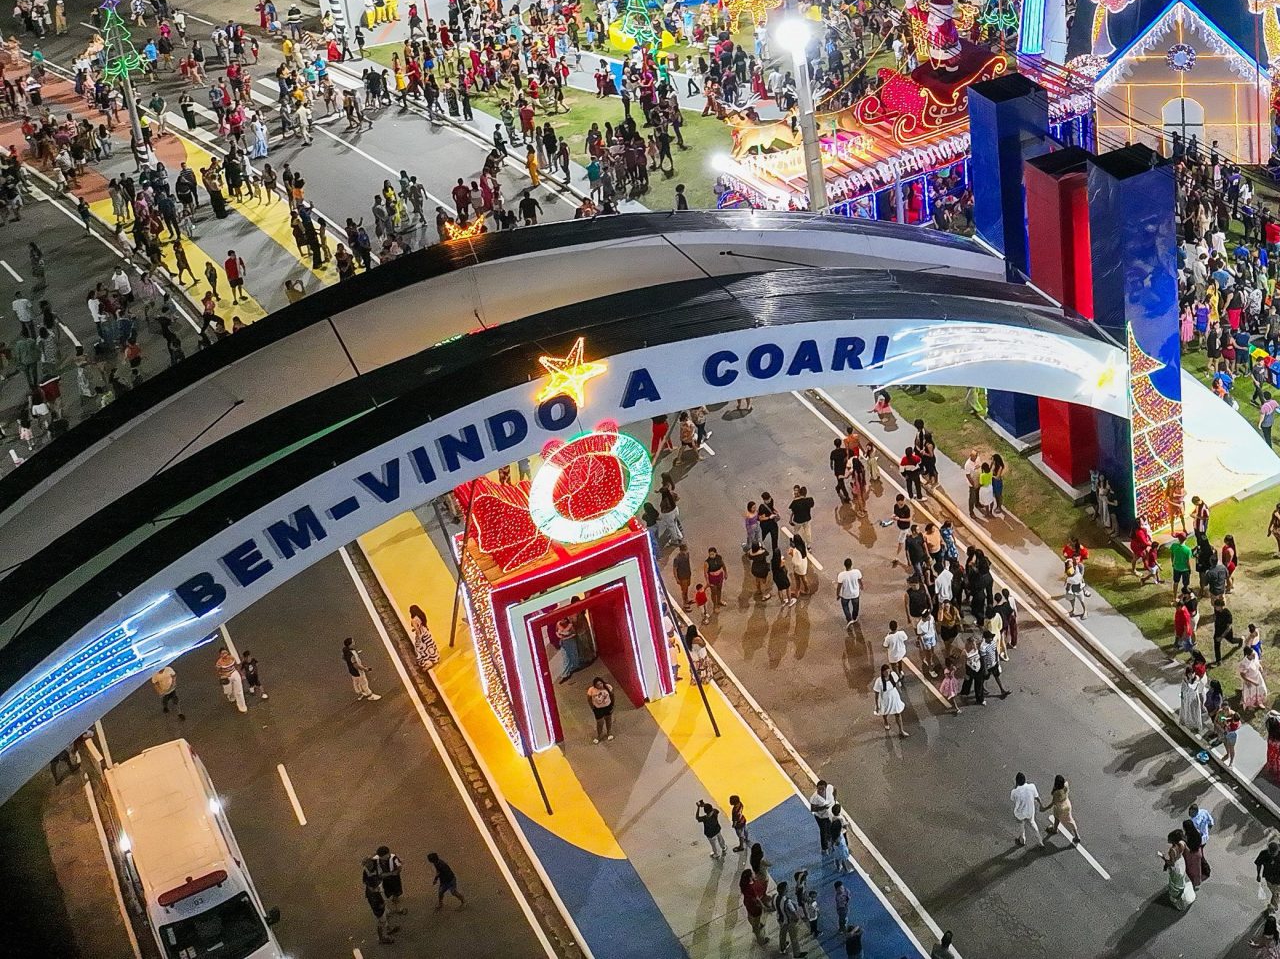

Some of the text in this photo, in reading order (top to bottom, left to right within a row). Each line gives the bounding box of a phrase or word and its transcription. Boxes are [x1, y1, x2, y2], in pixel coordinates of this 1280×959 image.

[175, 336, 889, 618] BEM-VINDO A COARI
